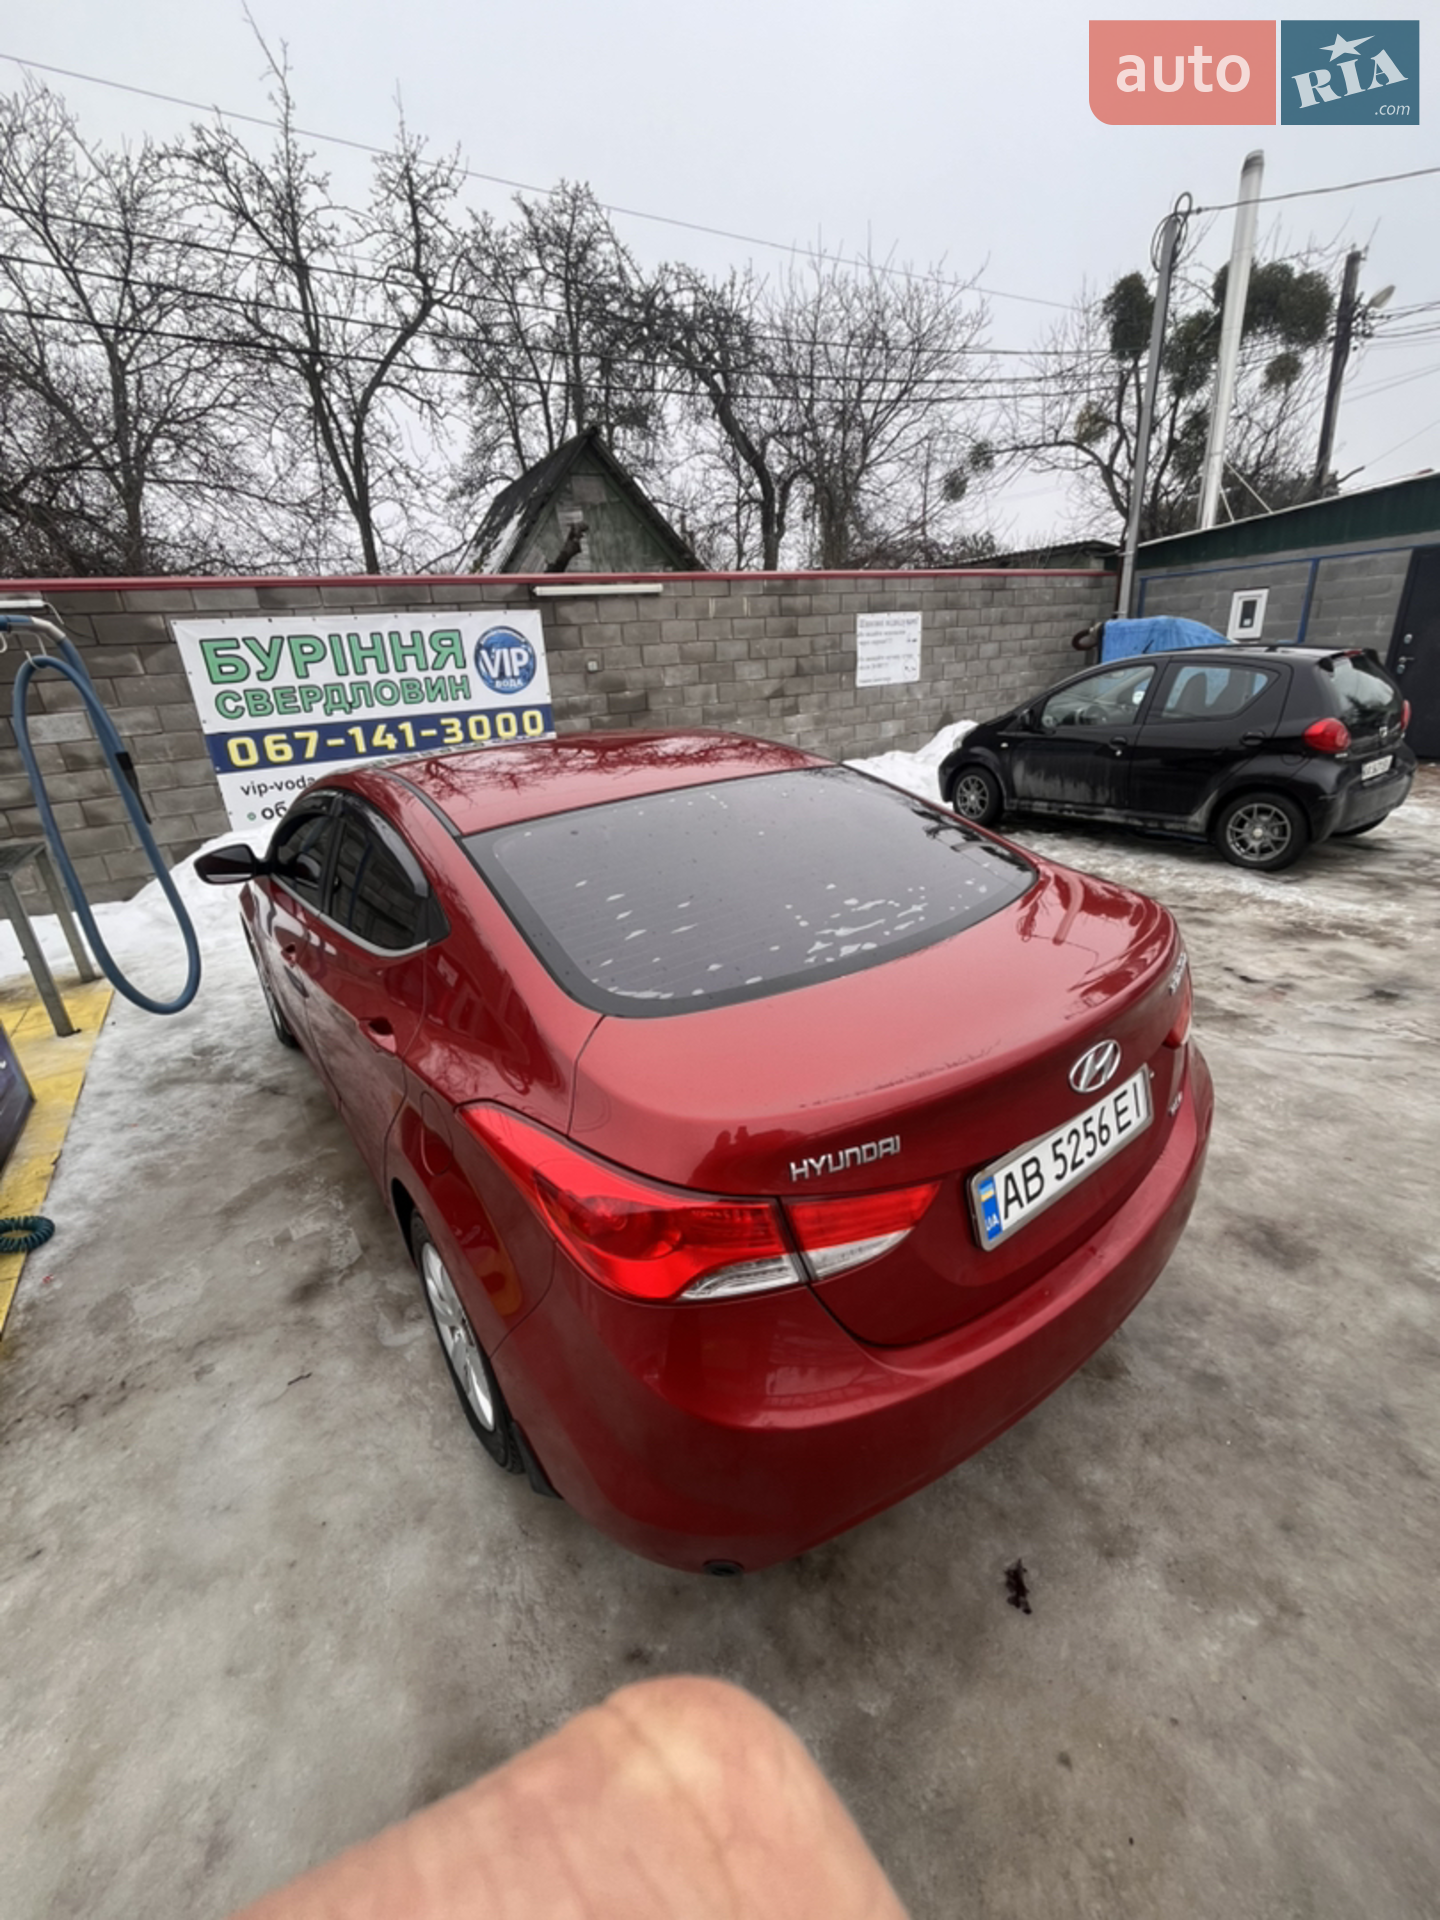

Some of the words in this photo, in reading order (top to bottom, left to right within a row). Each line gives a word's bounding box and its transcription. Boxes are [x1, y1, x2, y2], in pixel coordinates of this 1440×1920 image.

[199, 629, 467, 684] БУРІННЯ
[480, 647, 530, 679] VIP
[214, 675, 472, 720] СВЕРДЛОВИН
[226, 708, 545, 768] 067-141-3000
[790, 1135, 901, 1181] HYUNDAI
[1003, 1156, 1045, 1220] AB
[1052, 1106, 1111, 1182] 5256
[1115, 1081, 1142, 1135] EI
[985, 1213, 999, 1230] UA
